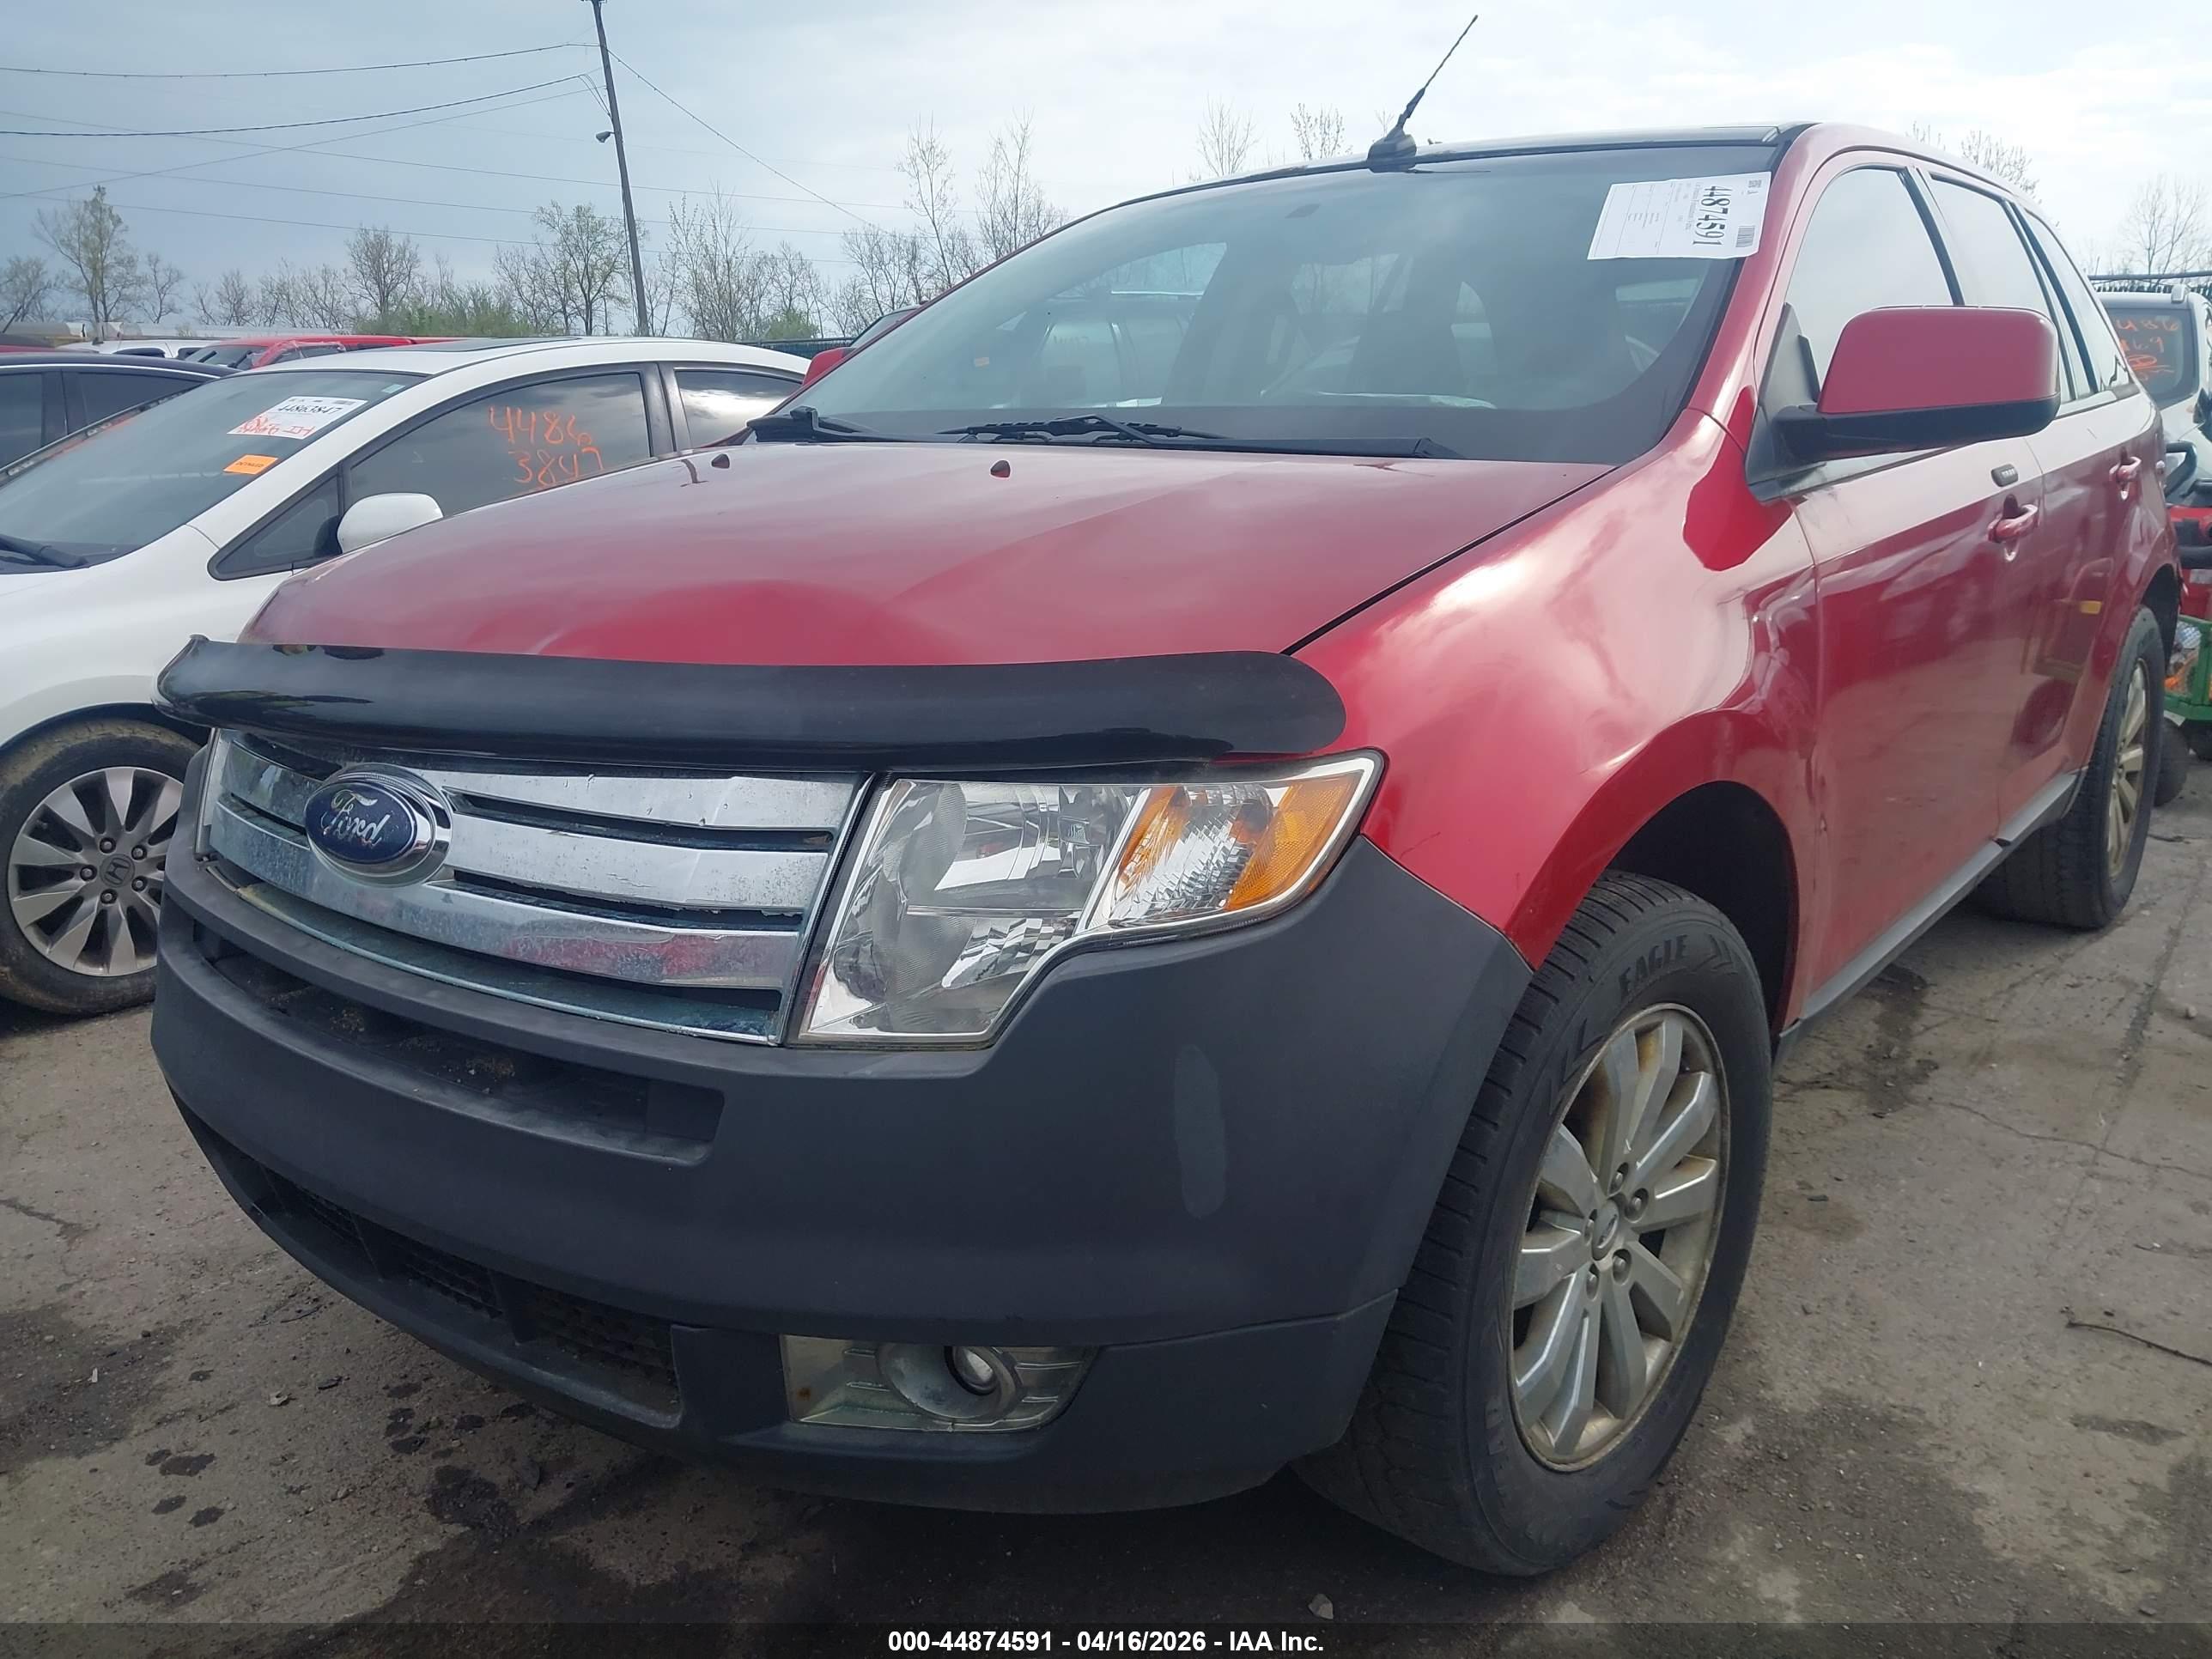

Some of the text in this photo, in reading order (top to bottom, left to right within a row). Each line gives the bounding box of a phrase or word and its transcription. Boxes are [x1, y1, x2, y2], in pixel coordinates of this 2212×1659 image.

[1692, 185, 1733, 246] 44874591
[277, 404, 343, 415] 44863847
[489, 405, 592, 447] 4486
[507, 447, 605, 487] 3847
[320, 789, 392, 848] Ford
[1619, 933, 1689, 1000] EAGLE
